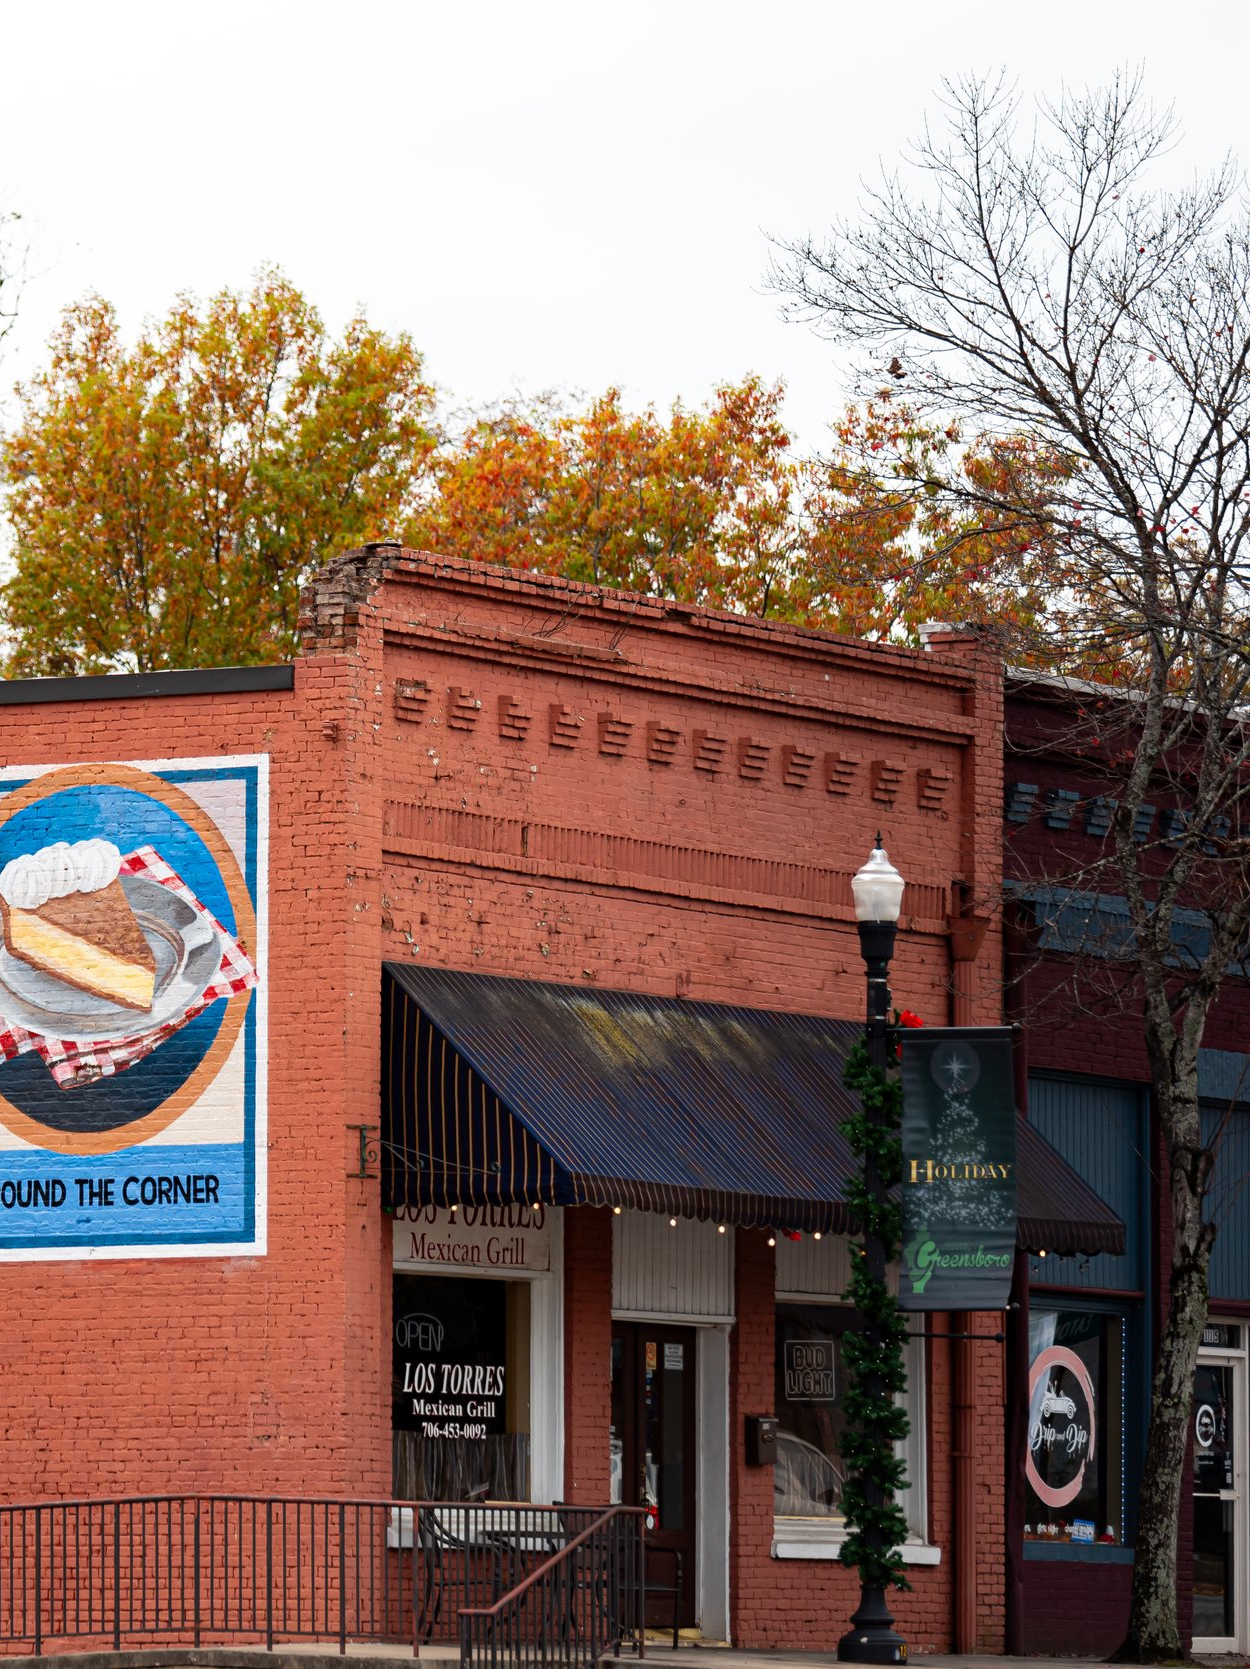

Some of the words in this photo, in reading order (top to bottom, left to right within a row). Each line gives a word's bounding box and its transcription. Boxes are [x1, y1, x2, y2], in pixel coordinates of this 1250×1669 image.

[74, 1177, 114, 1207] THE
[122, 1174, 220, 1206] CORNER
[409, 1231, 481, 1263] Mexican
[487, 1236, 526, 1266] Grill
[917, 1241, 1010, 1277] Greensboro
[395, 1319, 441, 1352] OPEN
[792, 1345, 826, 1370] BUD
[402, 1362, 437, 1394] LOS
[441, 1364, 505, 1397] TORRES
[786, 1370, 833, 1395] LIGHT
[412, 1399, 464, 1417] Mexican
[467, 1400, 496, 1418] Grill
[421, 1421, 487, 1440] 706-453-0092
